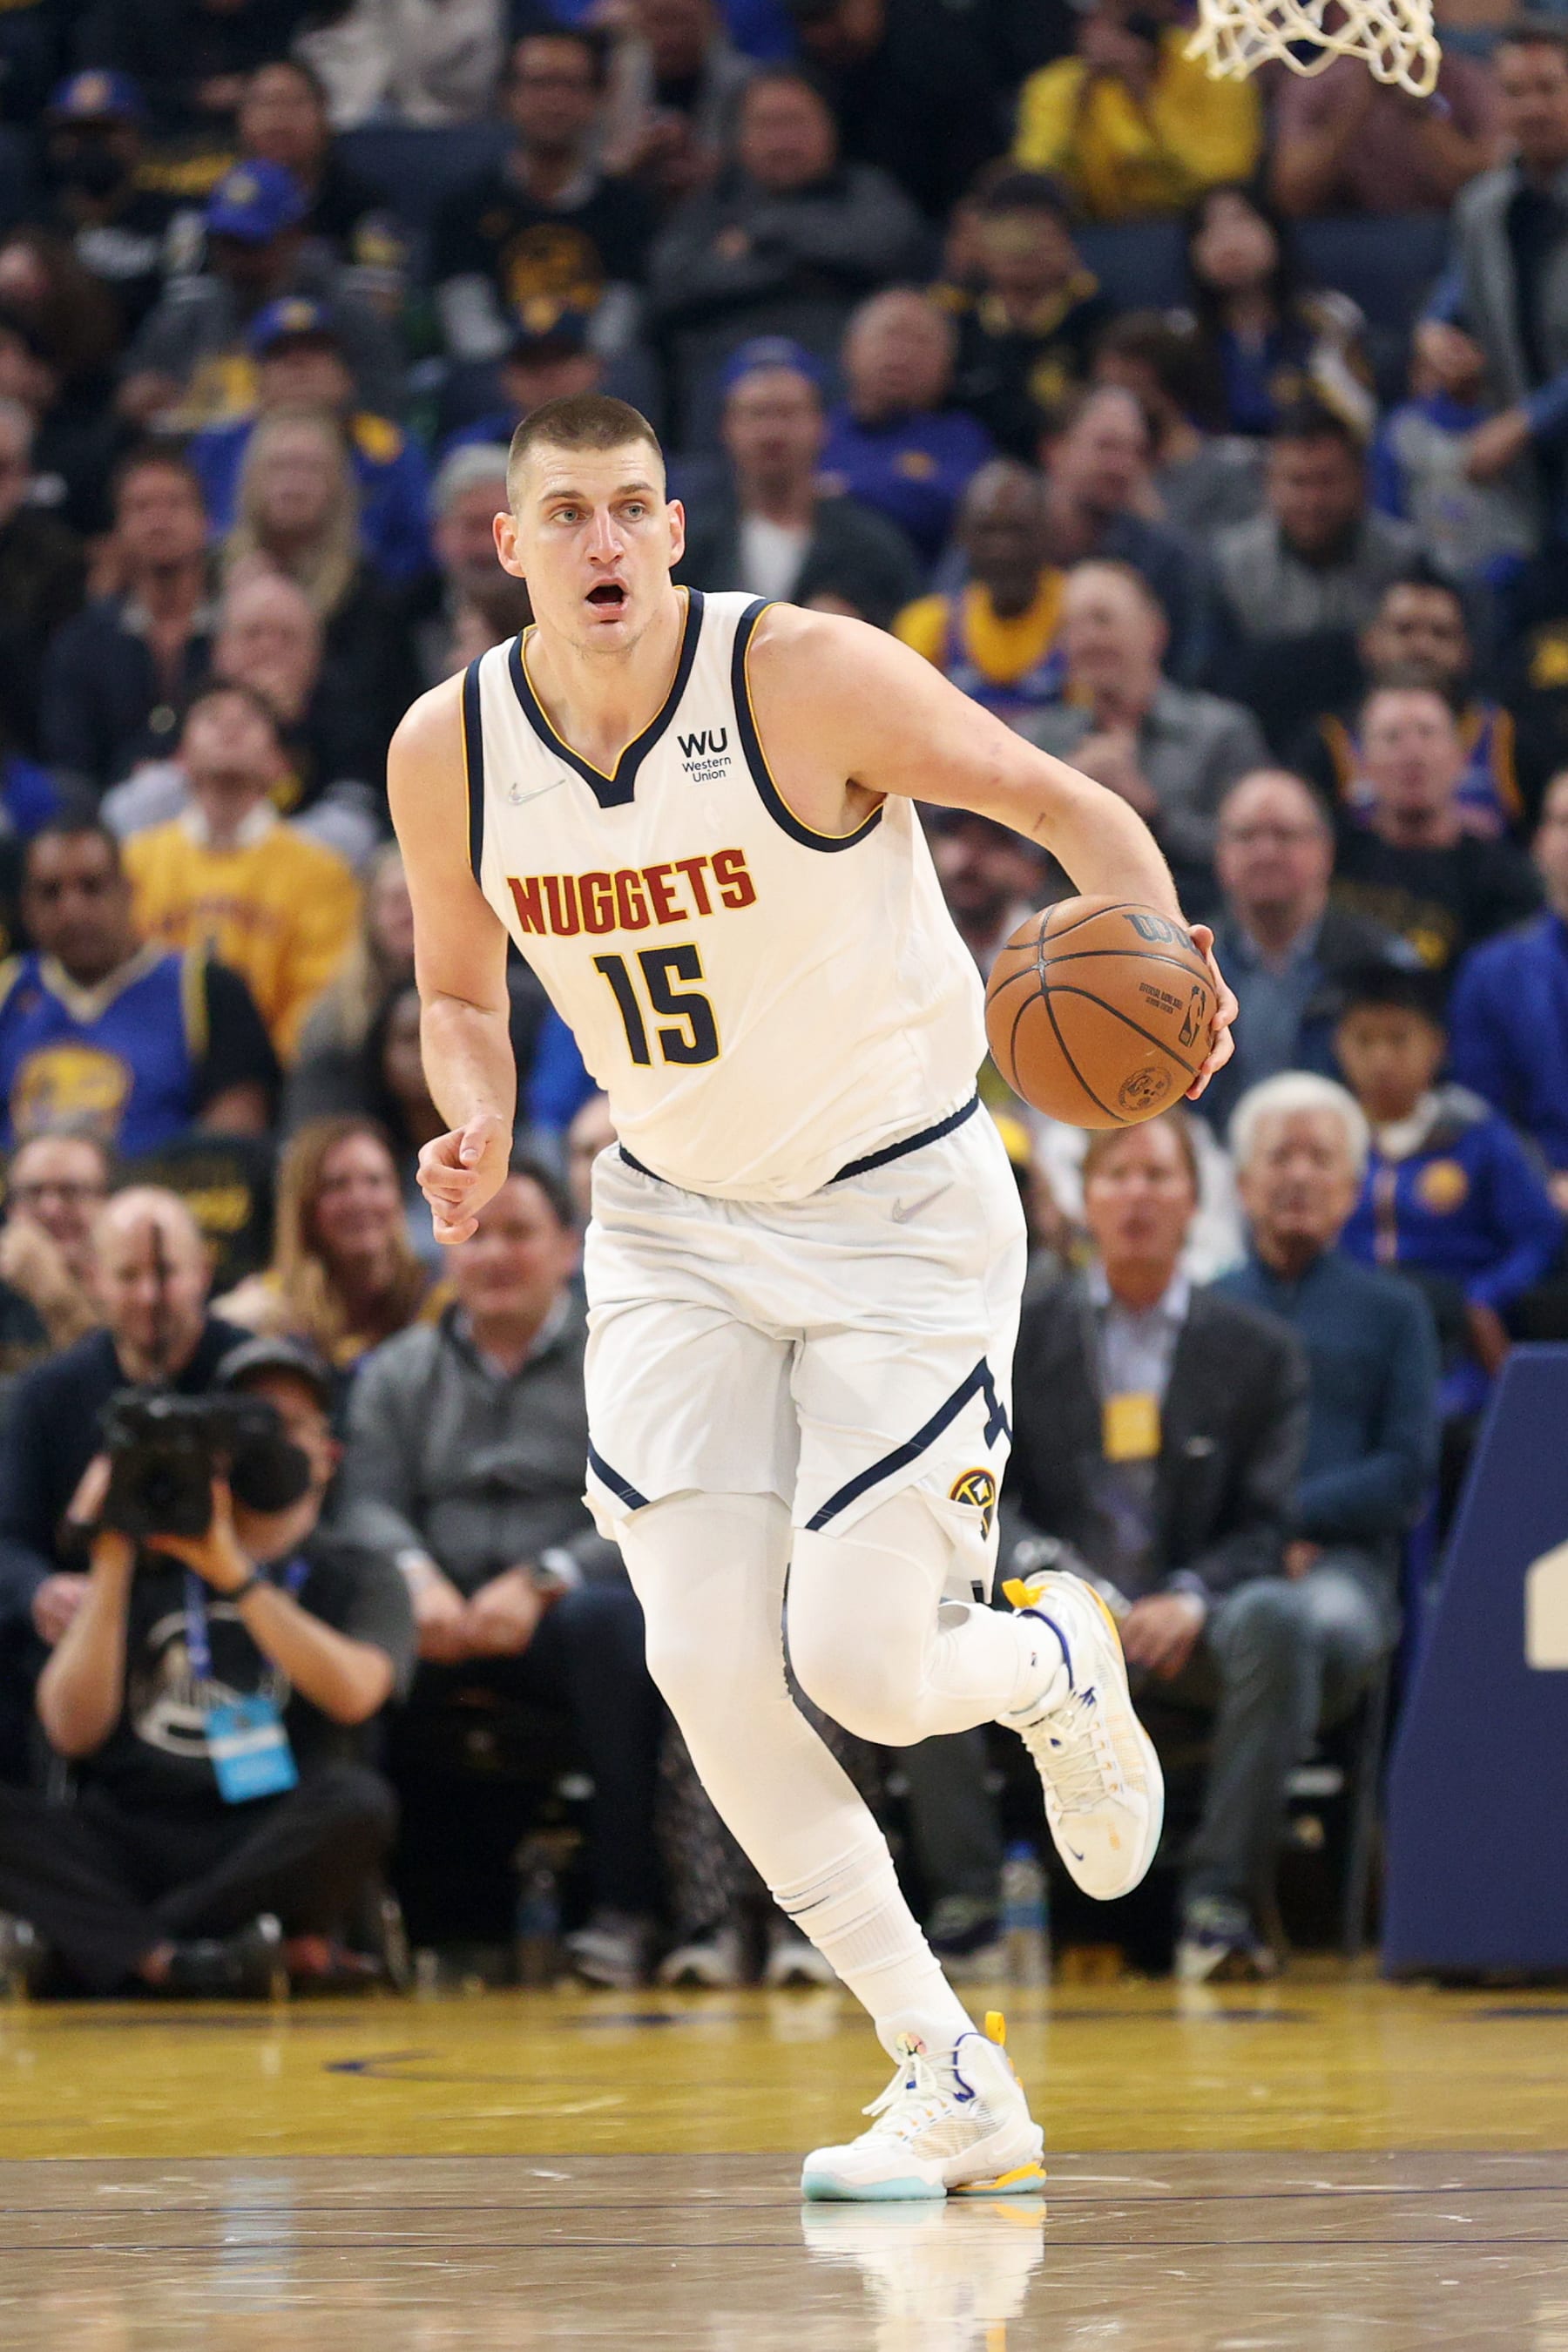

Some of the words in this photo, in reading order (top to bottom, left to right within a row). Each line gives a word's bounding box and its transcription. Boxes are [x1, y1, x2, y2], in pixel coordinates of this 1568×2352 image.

[677, 727, 727, 758] WU
[682, 756, 732, 773] Western
[693, 769, 726, 782] Union
[507, 848, 757, 936] NUGGETS
[590, 942, 721, 1067] 15
